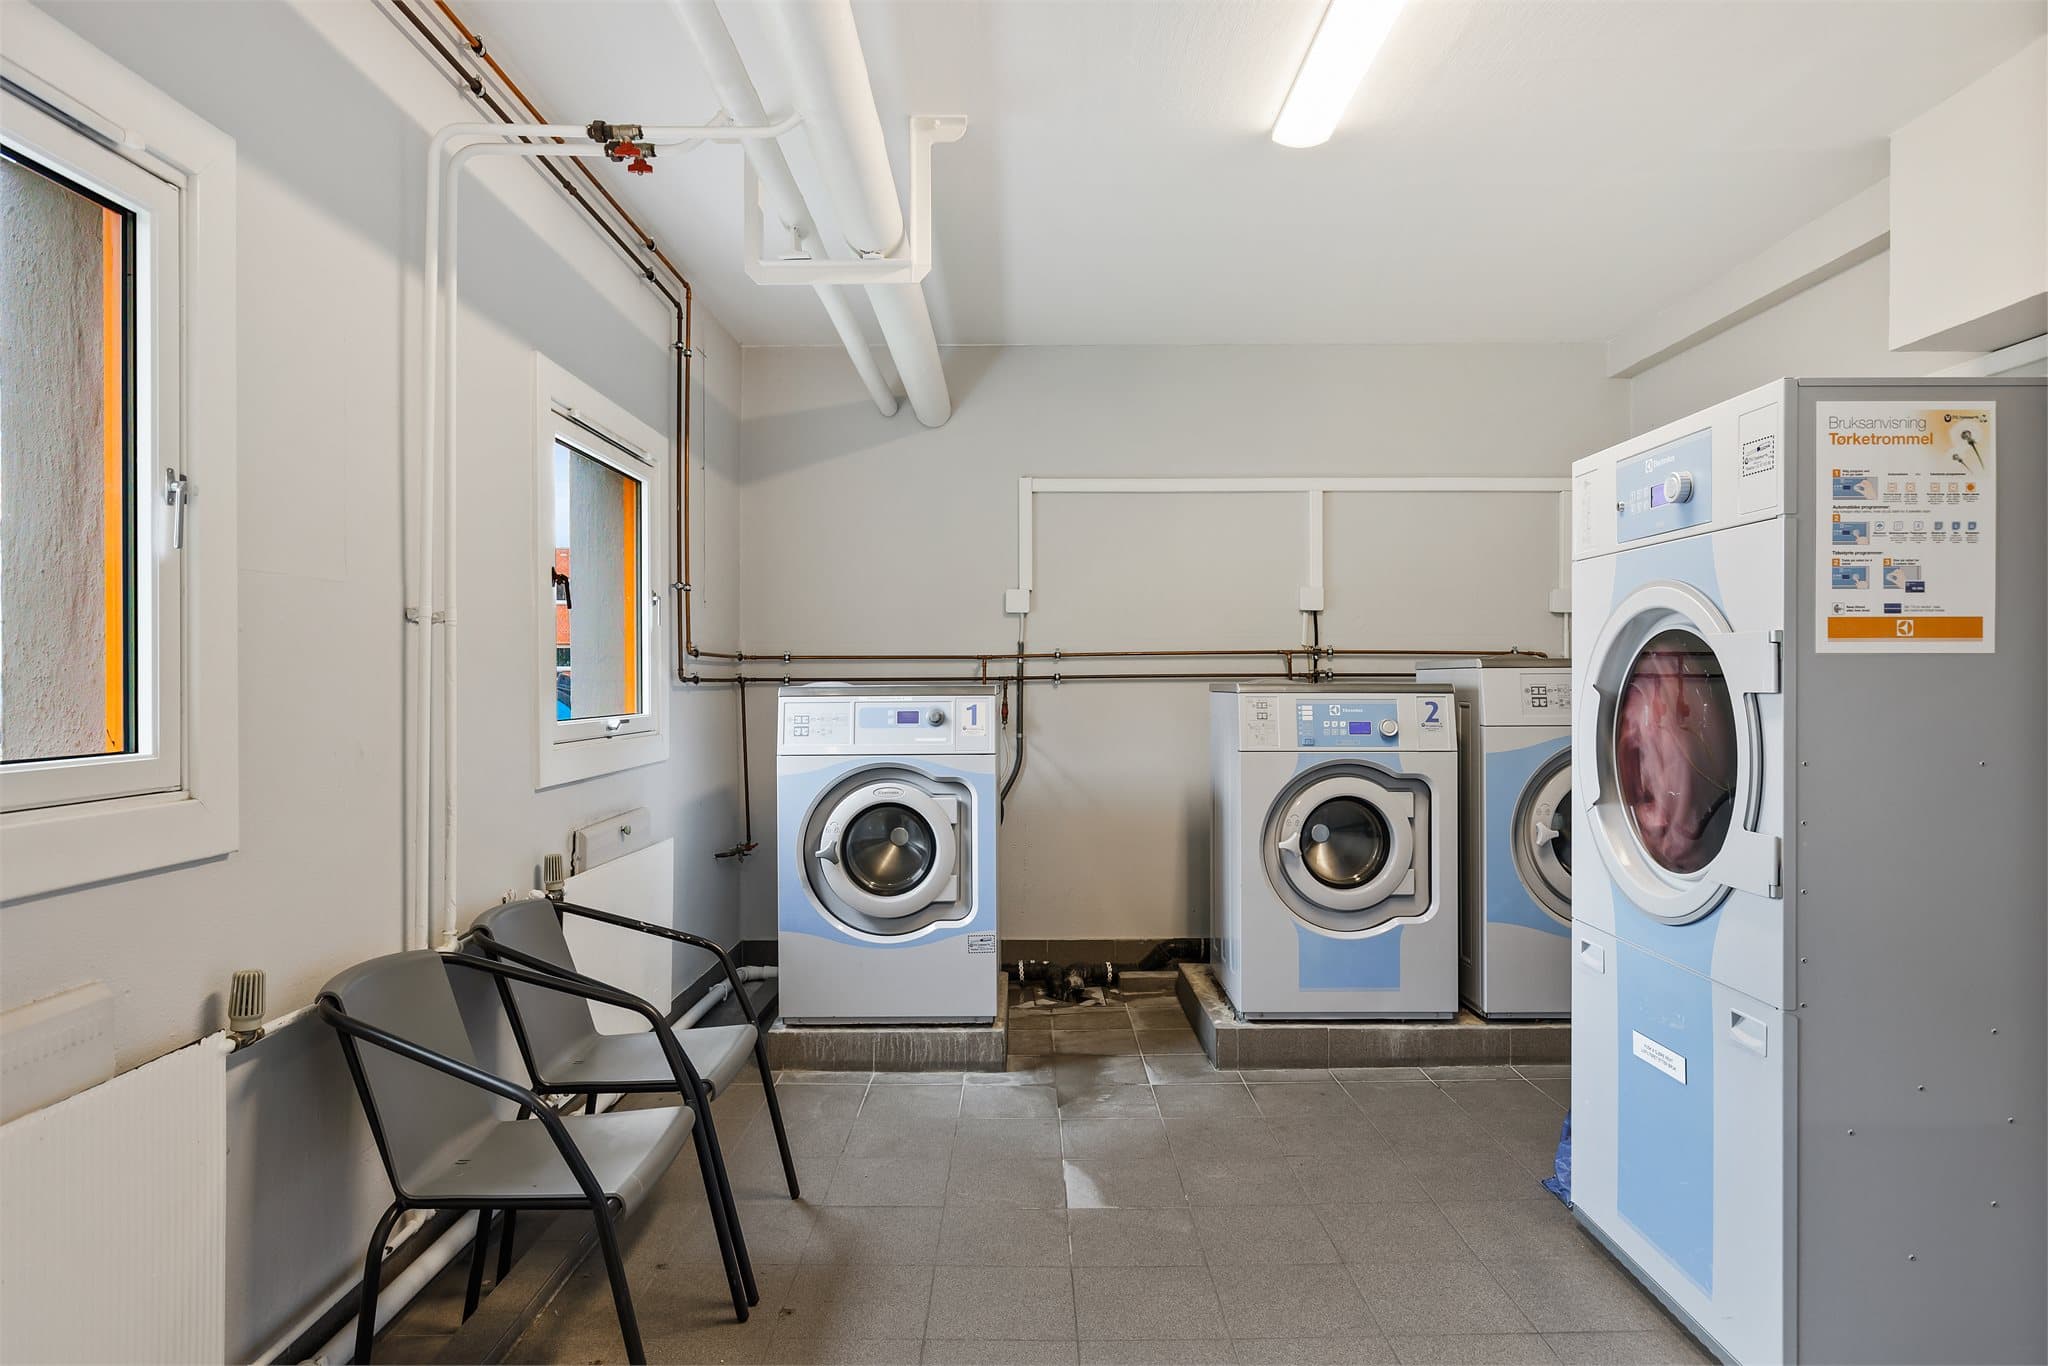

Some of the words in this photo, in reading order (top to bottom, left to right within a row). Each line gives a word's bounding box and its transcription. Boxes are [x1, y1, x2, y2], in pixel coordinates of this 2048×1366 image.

[1828, 415, 1927, 432] Bruksanvisning
[1828, 432, 1934, 445] Tørketrommel
[966, 704, 977, 726] 1
[1425, 701, 1440, 723] 2
